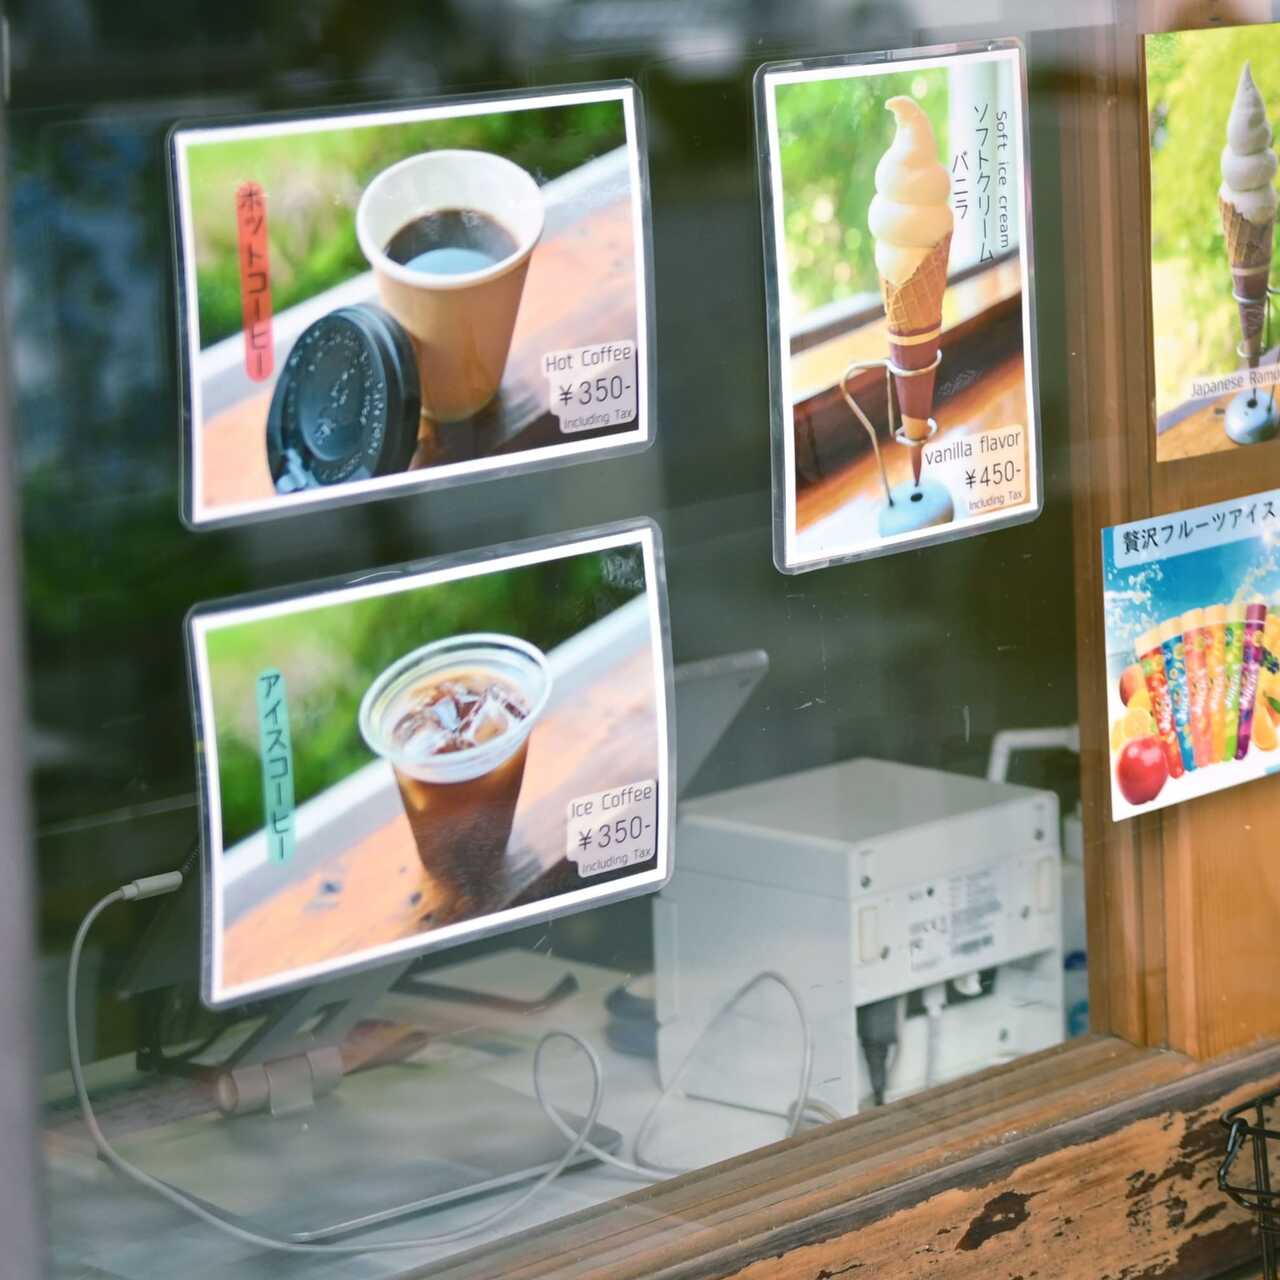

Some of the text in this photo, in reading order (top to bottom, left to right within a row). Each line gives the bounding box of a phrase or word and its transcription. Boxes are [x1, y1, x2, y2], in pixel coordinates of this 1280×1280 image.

[951, 150, 970, 220] バニラ
[973, 103, 994, 263] ソフトクリーム
[995, 111, 1009, 249] Soft ice cream
[237, 188, 270, 377] ホットコーヒー
[545, 345, 632, 372] Hot Coffee
[1190, 375, 1244, 397] Japanese
[563, 408, 632, 429] Including Tax
[924, 431, 1021, 465] vanilla flavor
[968, 489, 1023, 511] Including Tax
[1122, 501, 1276, 556] 贅沢フルーツアイス
[259, 673, 290, 860] アイスコーヒー
[571, 786, 652, 819] Ice Coffee
[582, 848, 651, 874] Including Tax
